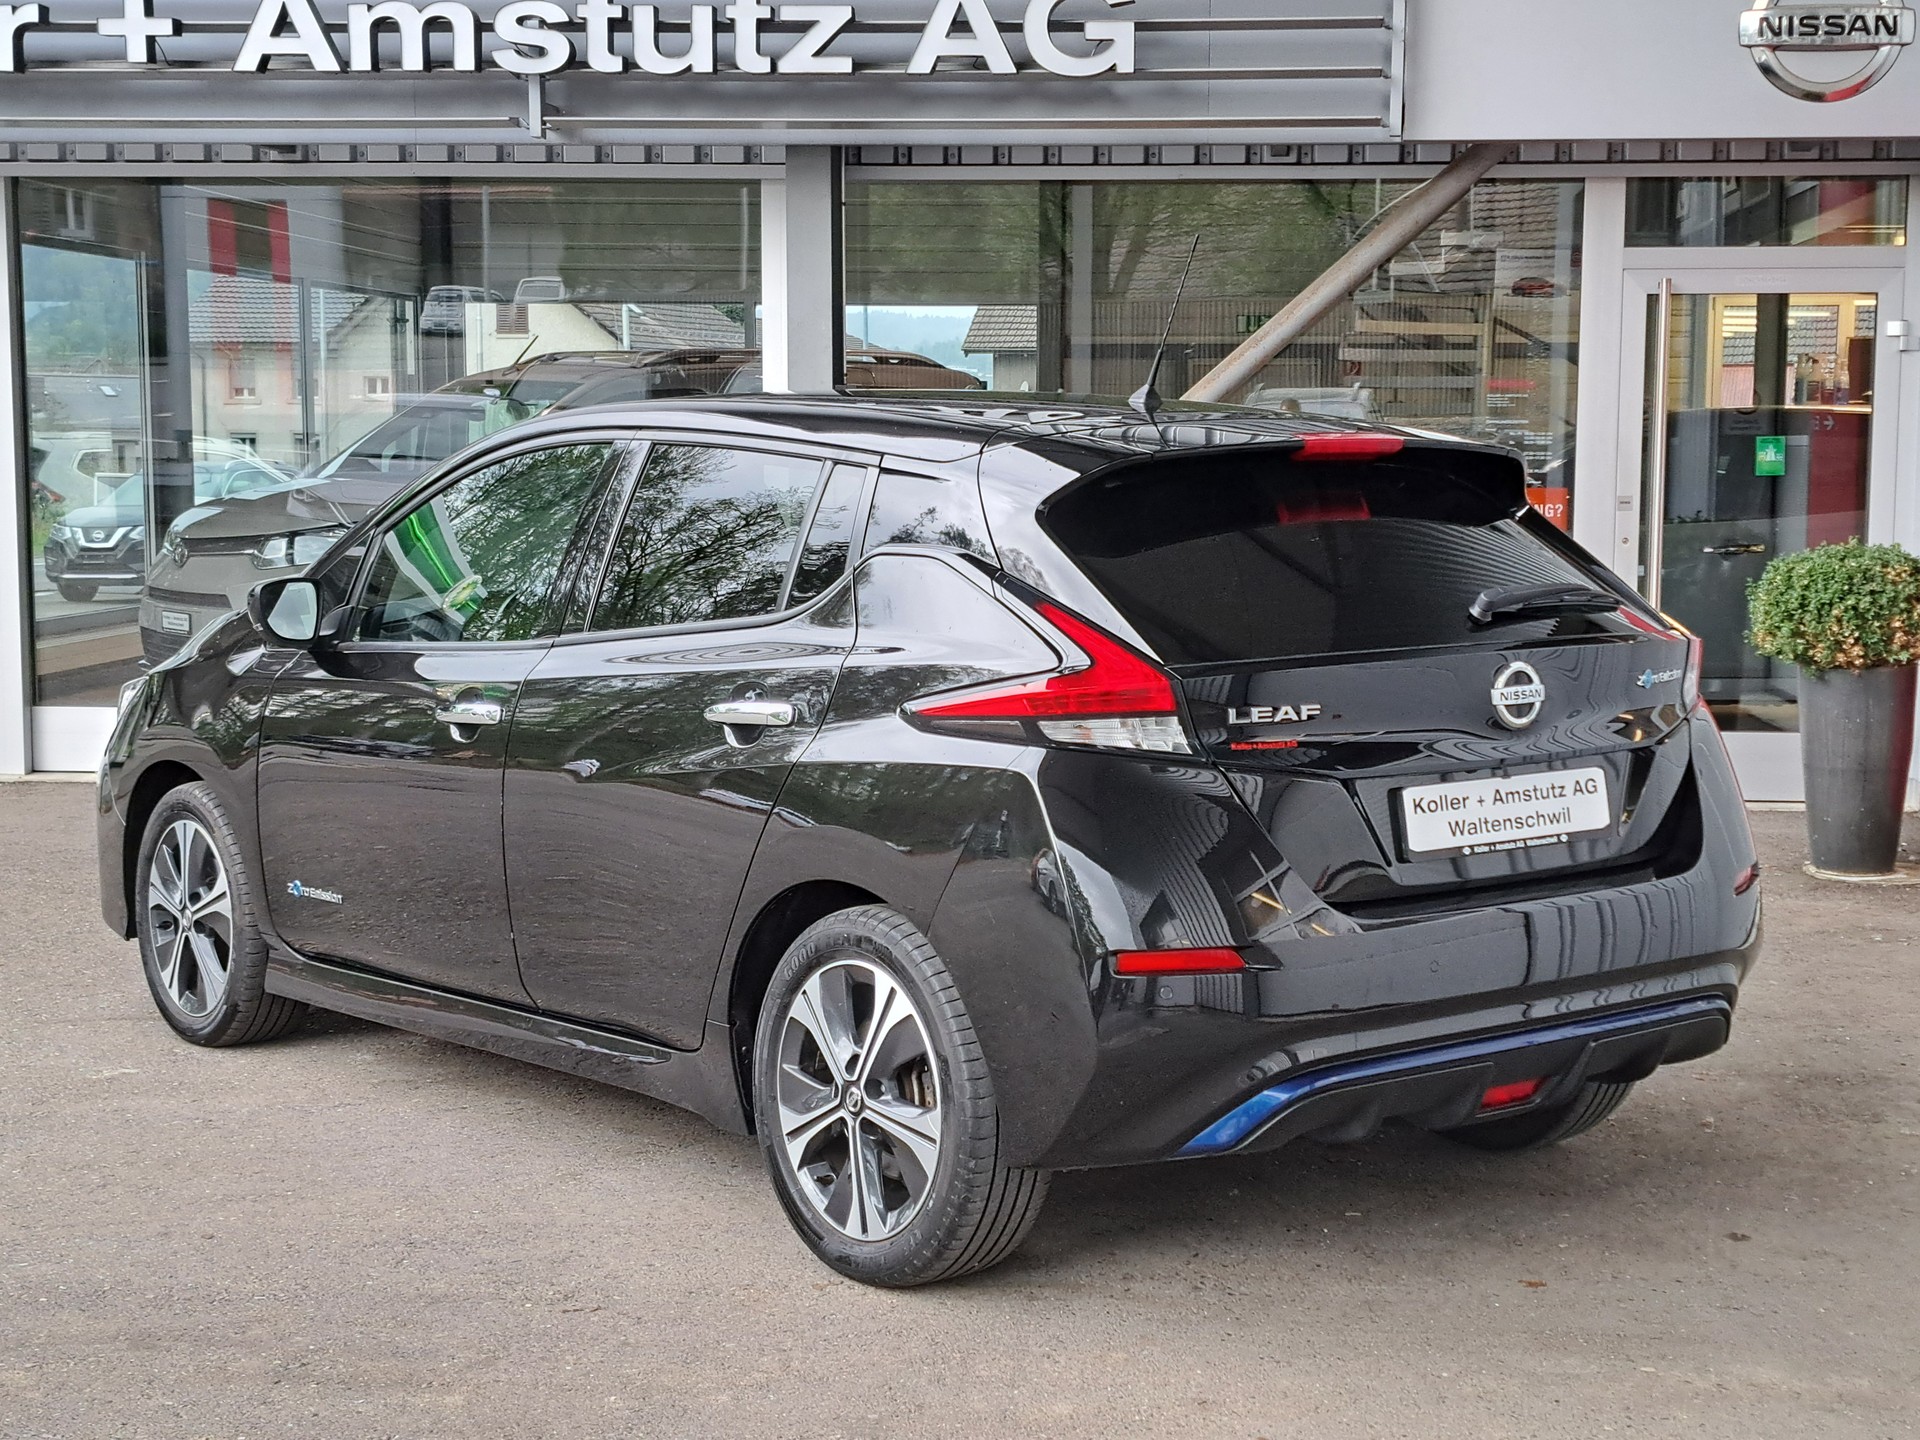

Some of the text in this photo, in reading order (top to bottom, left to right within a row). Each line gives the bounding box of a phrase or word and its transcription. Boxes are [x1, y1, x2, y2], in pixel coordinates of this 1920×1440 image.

[97, 0, 178, 63] +
[232, 0, 854, 75] Amstutz
[905, 0, 1136, 77] AG
[1757, 14, 1899, 37] NISSAN
[1499, 688, 1542, 701] NISSAN
[1228, 704, 1321, 724] LEAF
[1412, 778, 1598, 815] Koller + Amstutz AG
[1448, 807, 1572, 837] Waltenschwil
